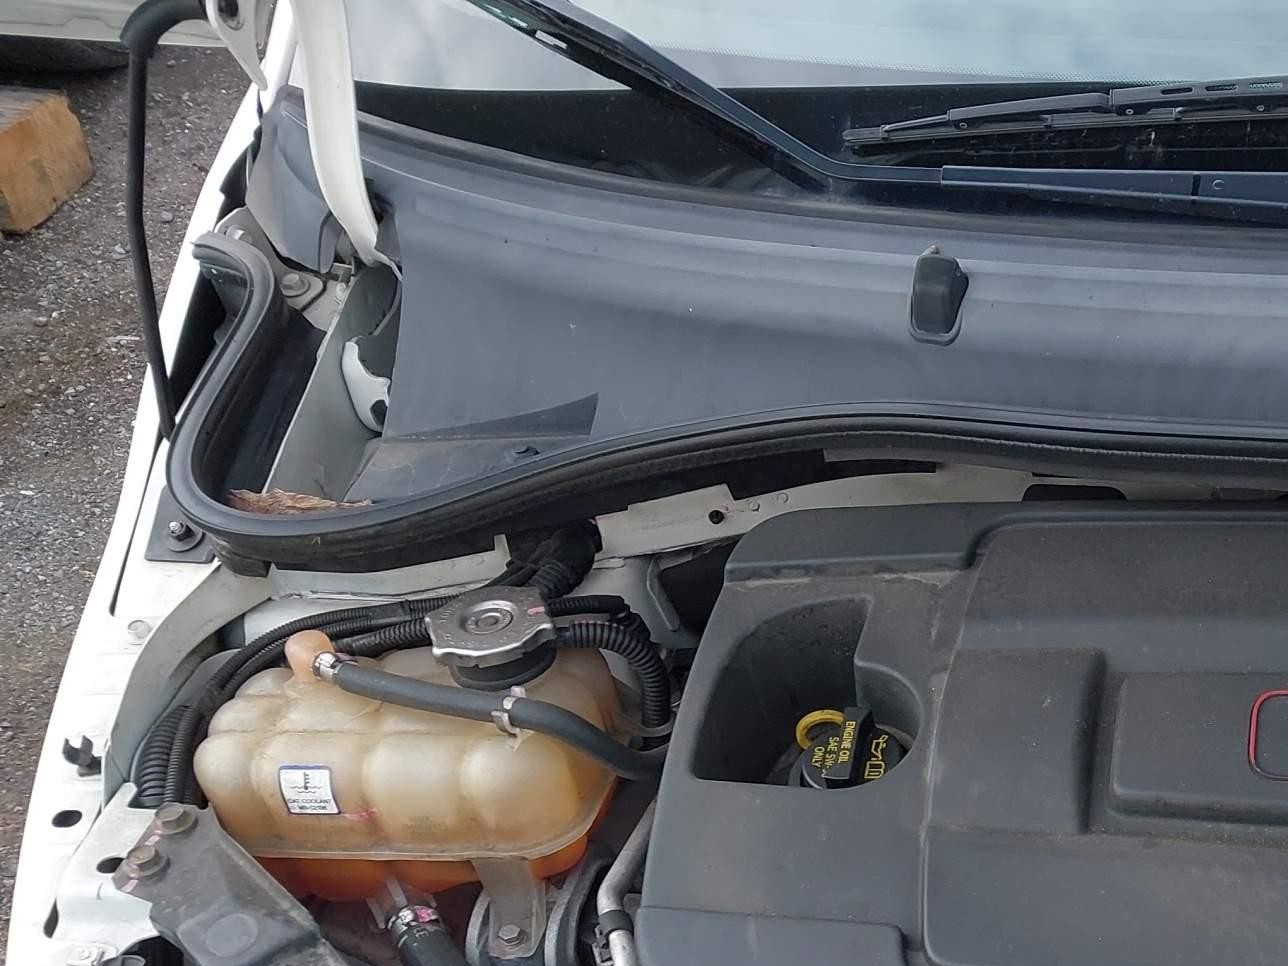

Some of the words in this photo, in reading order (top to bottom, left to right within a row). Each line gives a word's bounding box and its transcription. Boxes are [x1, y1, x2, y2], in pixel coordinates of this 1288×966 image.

[827, 736, 840, 752] SAE
[841, 721, 856, 749] ENGINE
[812, 746, 825, 767] ONLY
[838, 750, 849, 763] OIL
